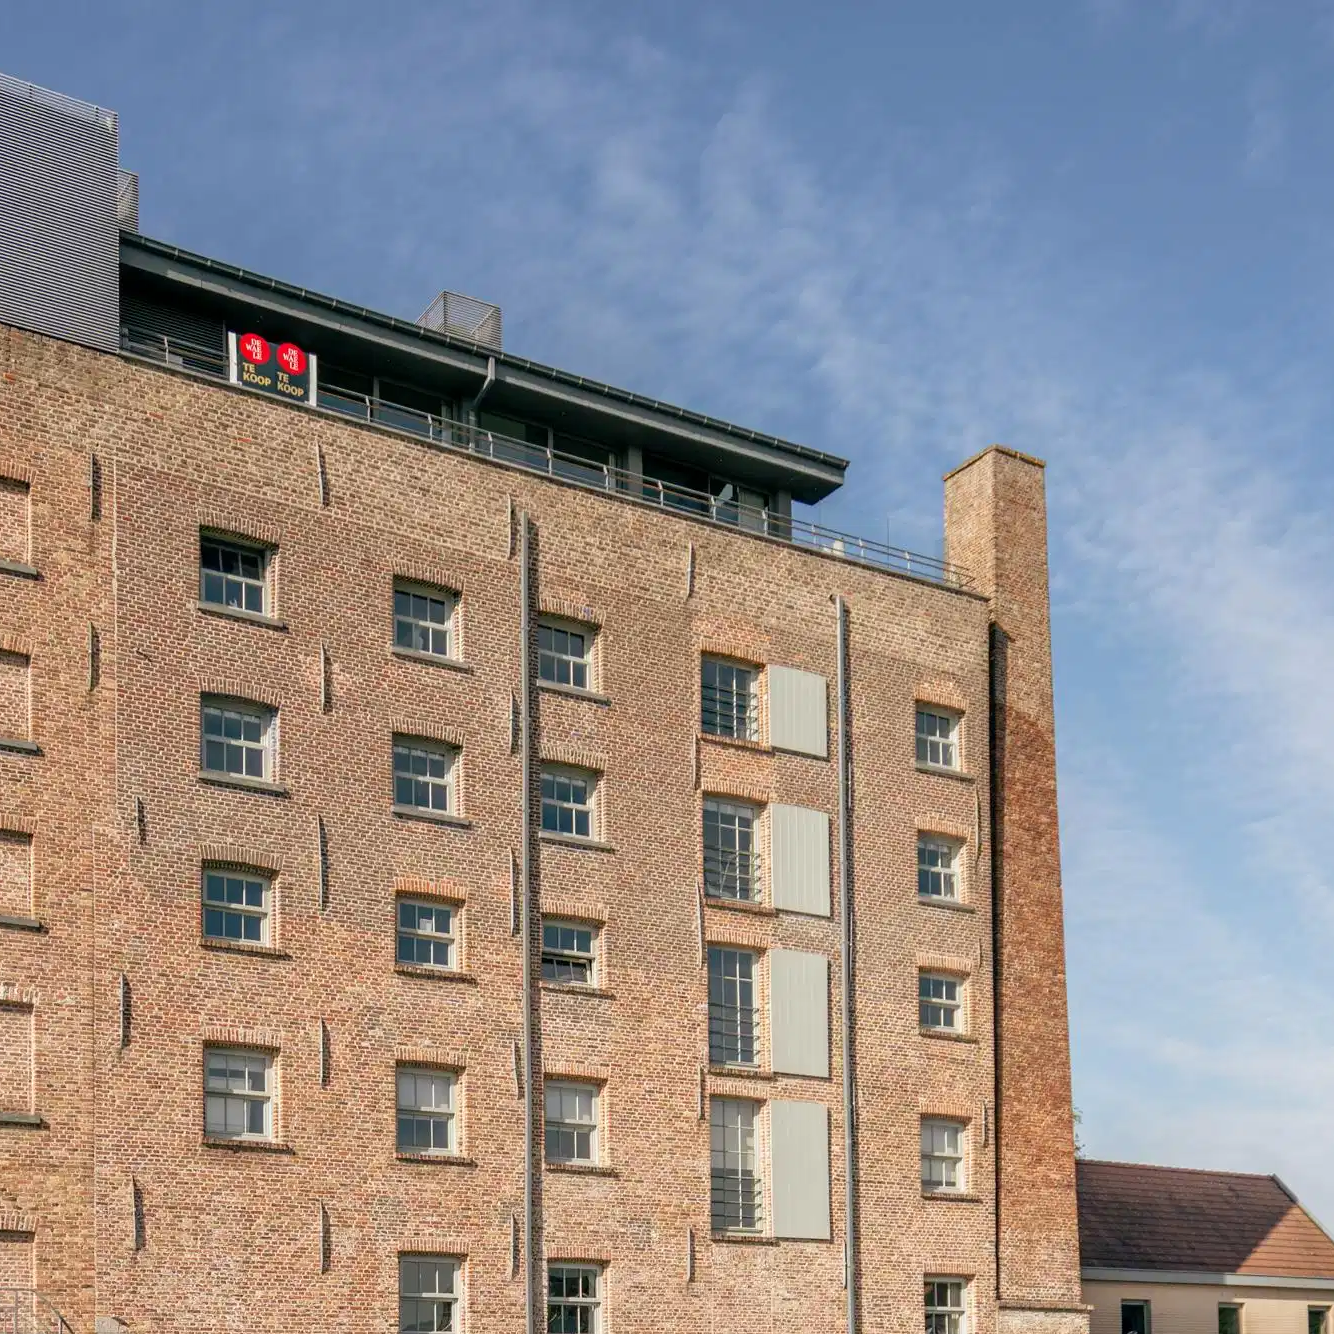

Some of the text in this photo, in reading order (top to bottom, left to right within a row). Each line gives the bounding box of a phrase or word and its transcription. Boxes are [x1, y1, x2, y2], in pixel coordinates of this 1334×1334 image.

[251, 338, 262, 346] DE
[245, 343, 262, 353] WAE
[288, 347, 298, 356] DE
[252, 351, 262, 361] LE
[282, 352, 298, 363] WAE
[243, 362, 255, 372] TE
[289, 361, 299, 371] LE
[242, 372, 271, 386] KOOP
[277, 371, 289, 383] TE
[277, 381, 304, 397] KOOP
